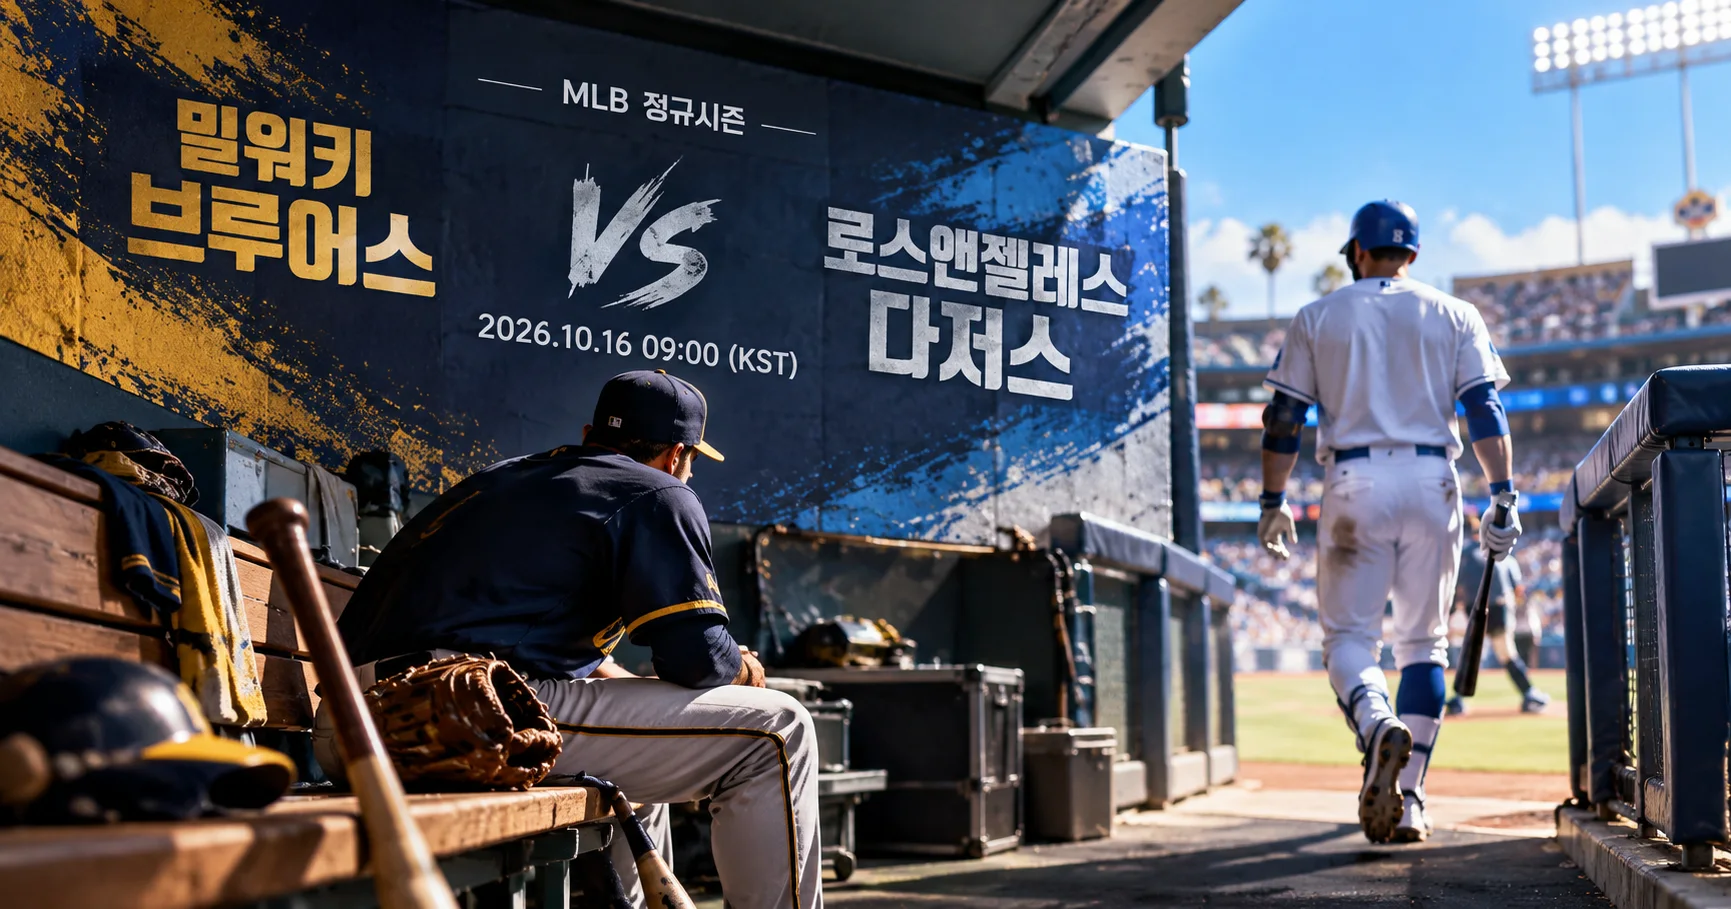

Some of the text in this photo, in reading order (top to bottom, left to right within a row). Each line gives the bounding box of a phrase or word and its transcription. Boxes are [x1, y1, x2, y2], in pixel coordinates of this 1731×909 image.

[176, 98, 372, 197] 밀워키
[563, 78, 746, 136] MLB 정규시즌
[127, 171, 436, 298] 브루어스
[567, 156, 722, 310] VS
[823, 206, 1129, 317] 로스앤젤레스
[478, 313, 798, 380] 2026.10.16 09:00 (KST)
[868, 289, 1074, 401] 다저스
